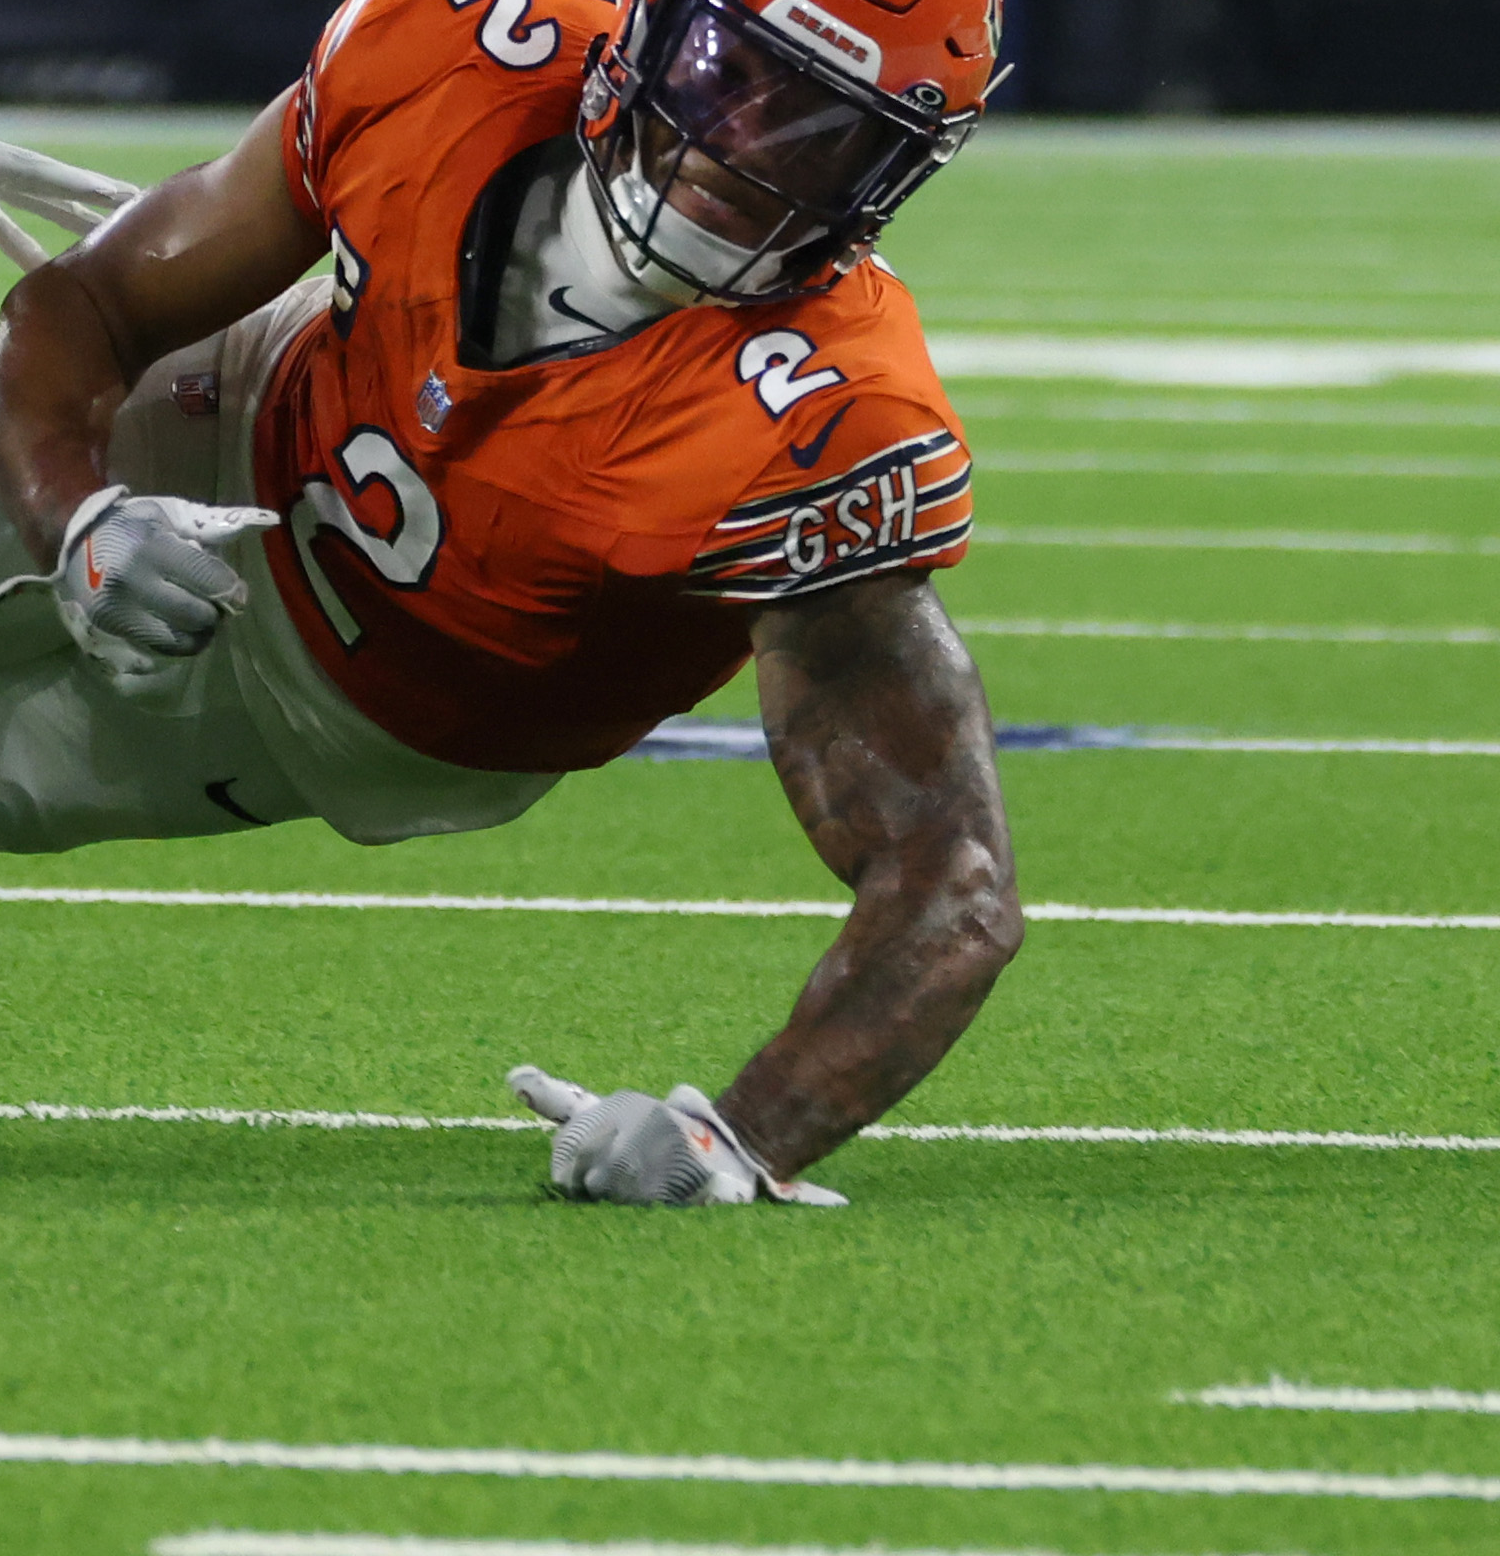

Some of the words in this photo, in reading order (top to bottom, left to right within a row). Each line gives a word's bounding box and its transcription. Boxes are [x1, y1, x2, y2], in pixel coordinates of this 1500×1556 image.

[787, 6, 868, 64] BEARS
[736, 328, 844, 419] 2
[288, 423, 444, 649] 2
[784, 464, 917, 574] GSH
